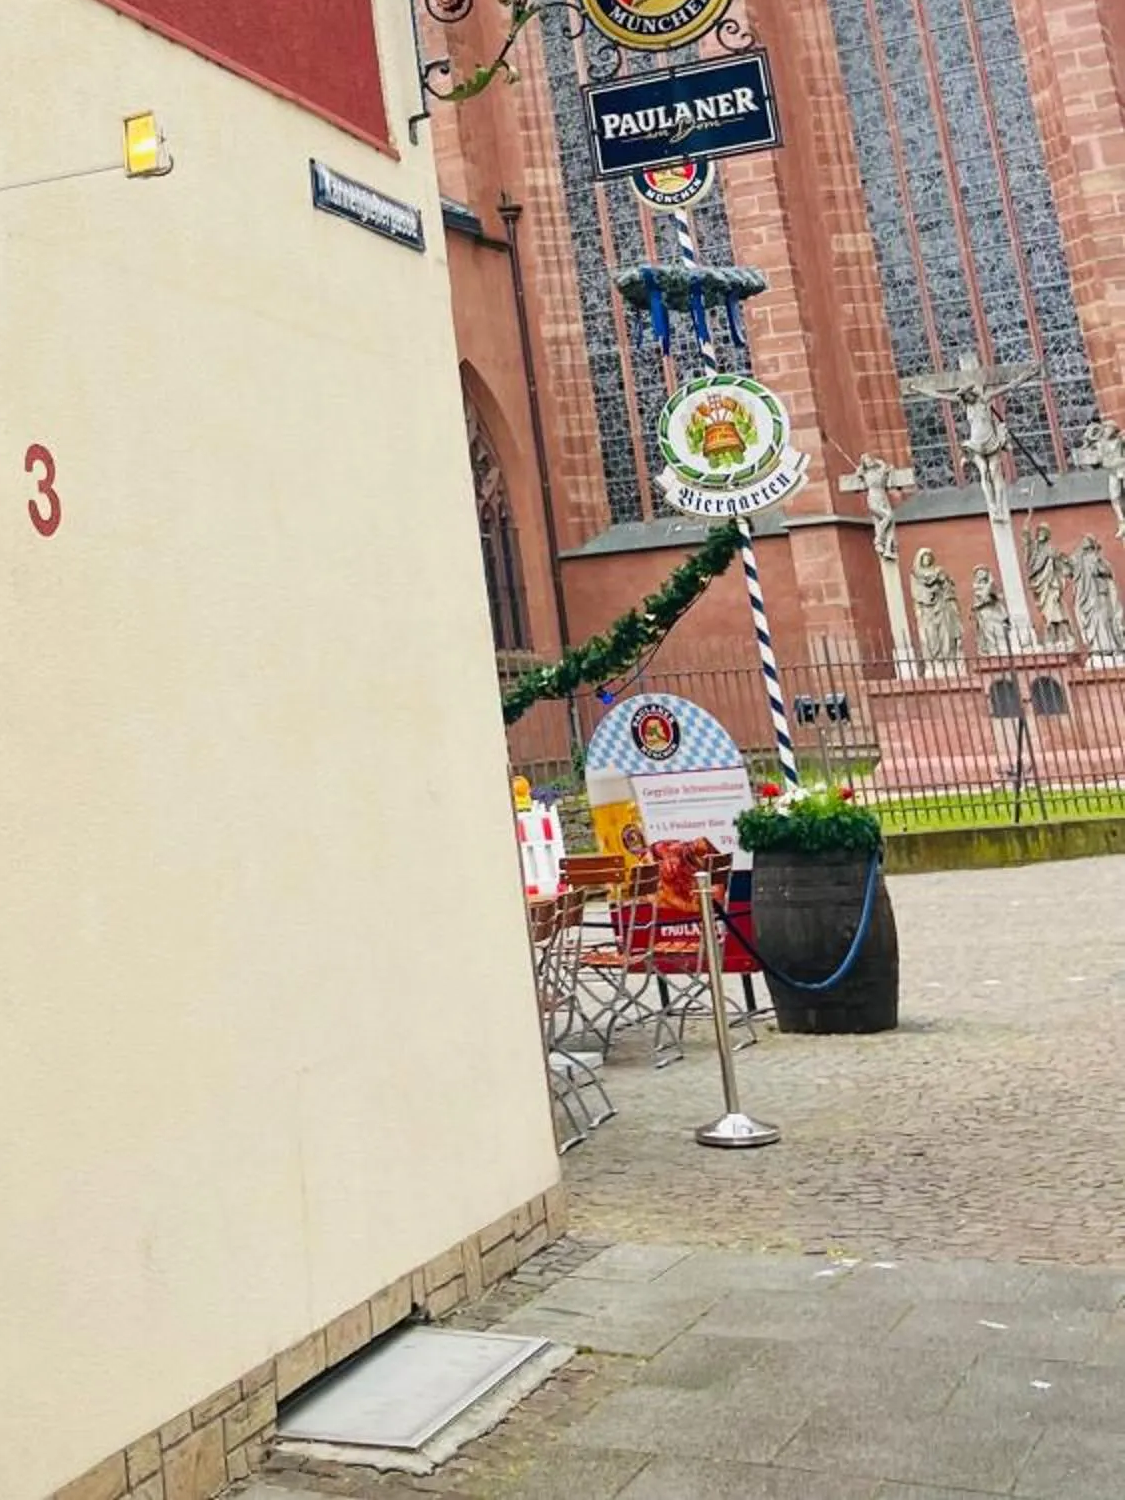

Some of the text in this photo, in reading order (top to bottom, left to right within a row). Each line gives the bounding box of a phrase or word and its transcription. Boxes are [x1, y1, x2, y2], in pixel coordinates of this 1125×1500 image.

[601, 87, 760, 140] PAULANER
[645, 178, 702, 203] MÜNCHEN
[25, 444, 61, 537] 3
[677, 471, 791, 516] Biergarten
